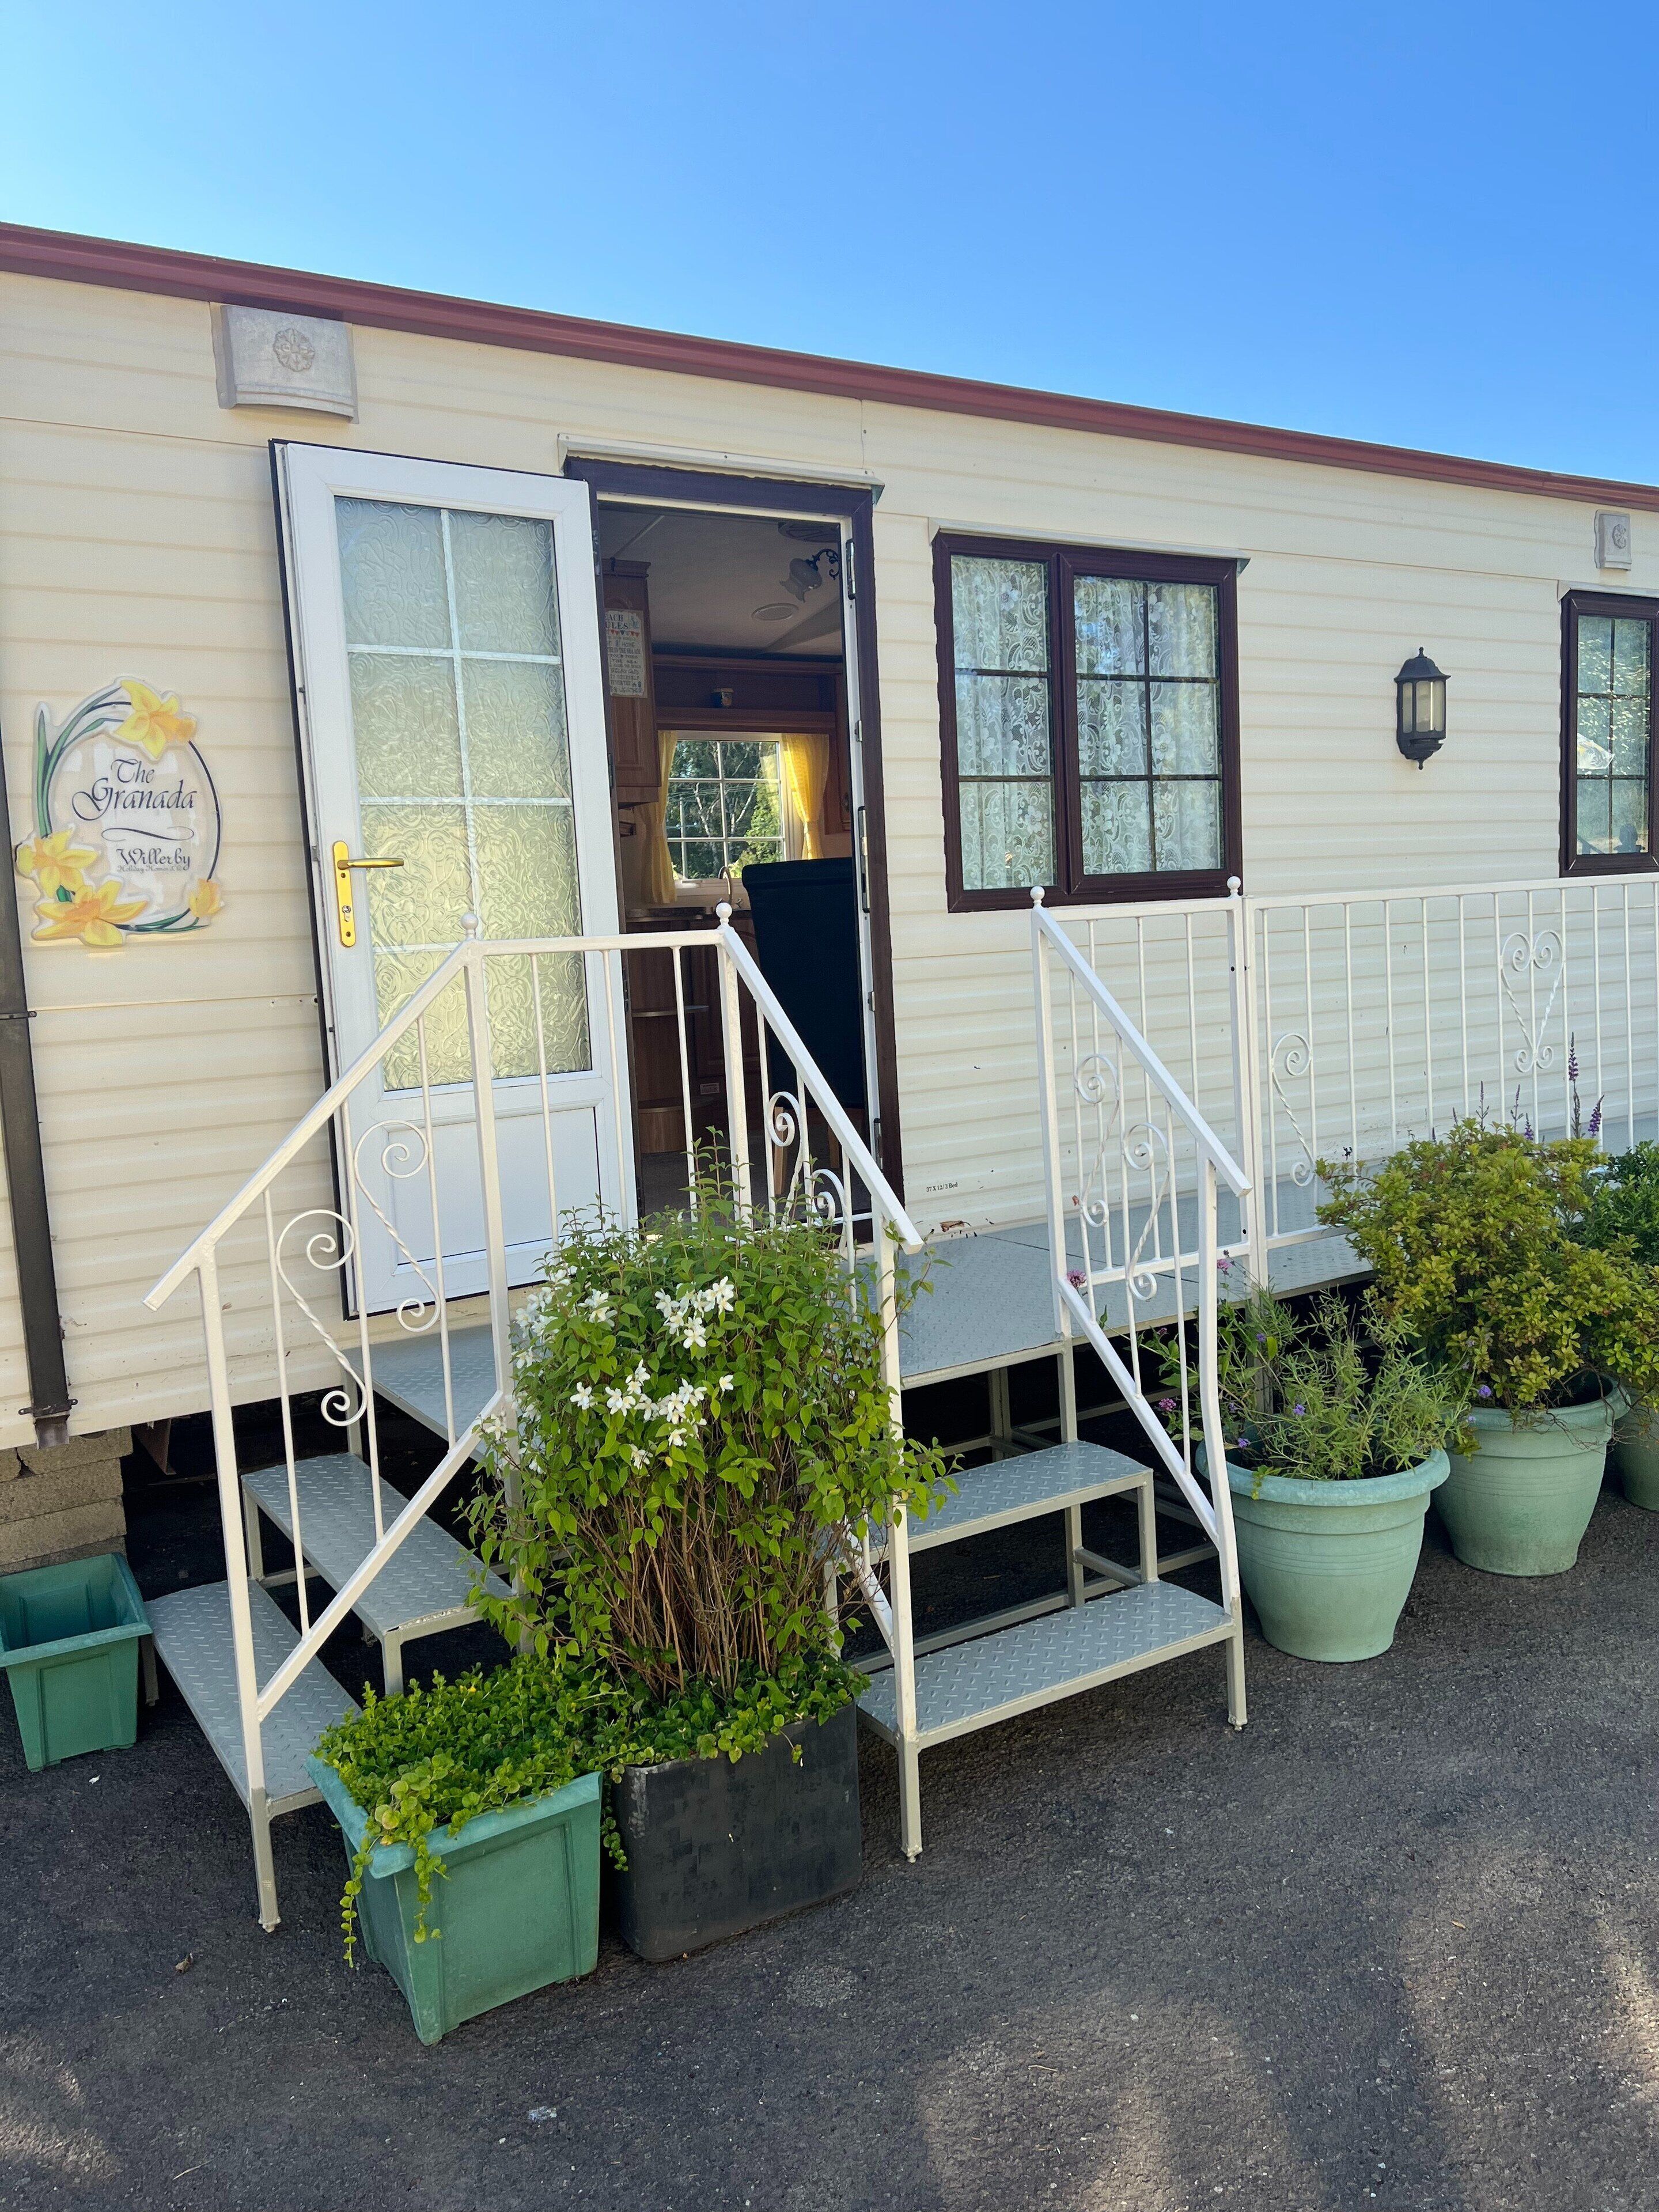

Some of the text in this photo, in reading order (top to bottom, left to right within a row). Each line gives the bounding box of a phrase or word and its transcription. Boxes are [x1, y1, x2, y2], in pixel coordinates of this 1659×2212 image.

[111, 759, 155, 783] The
[71, 777, 197, 821] Granada
[116, 847, 190, 871] Willerby
